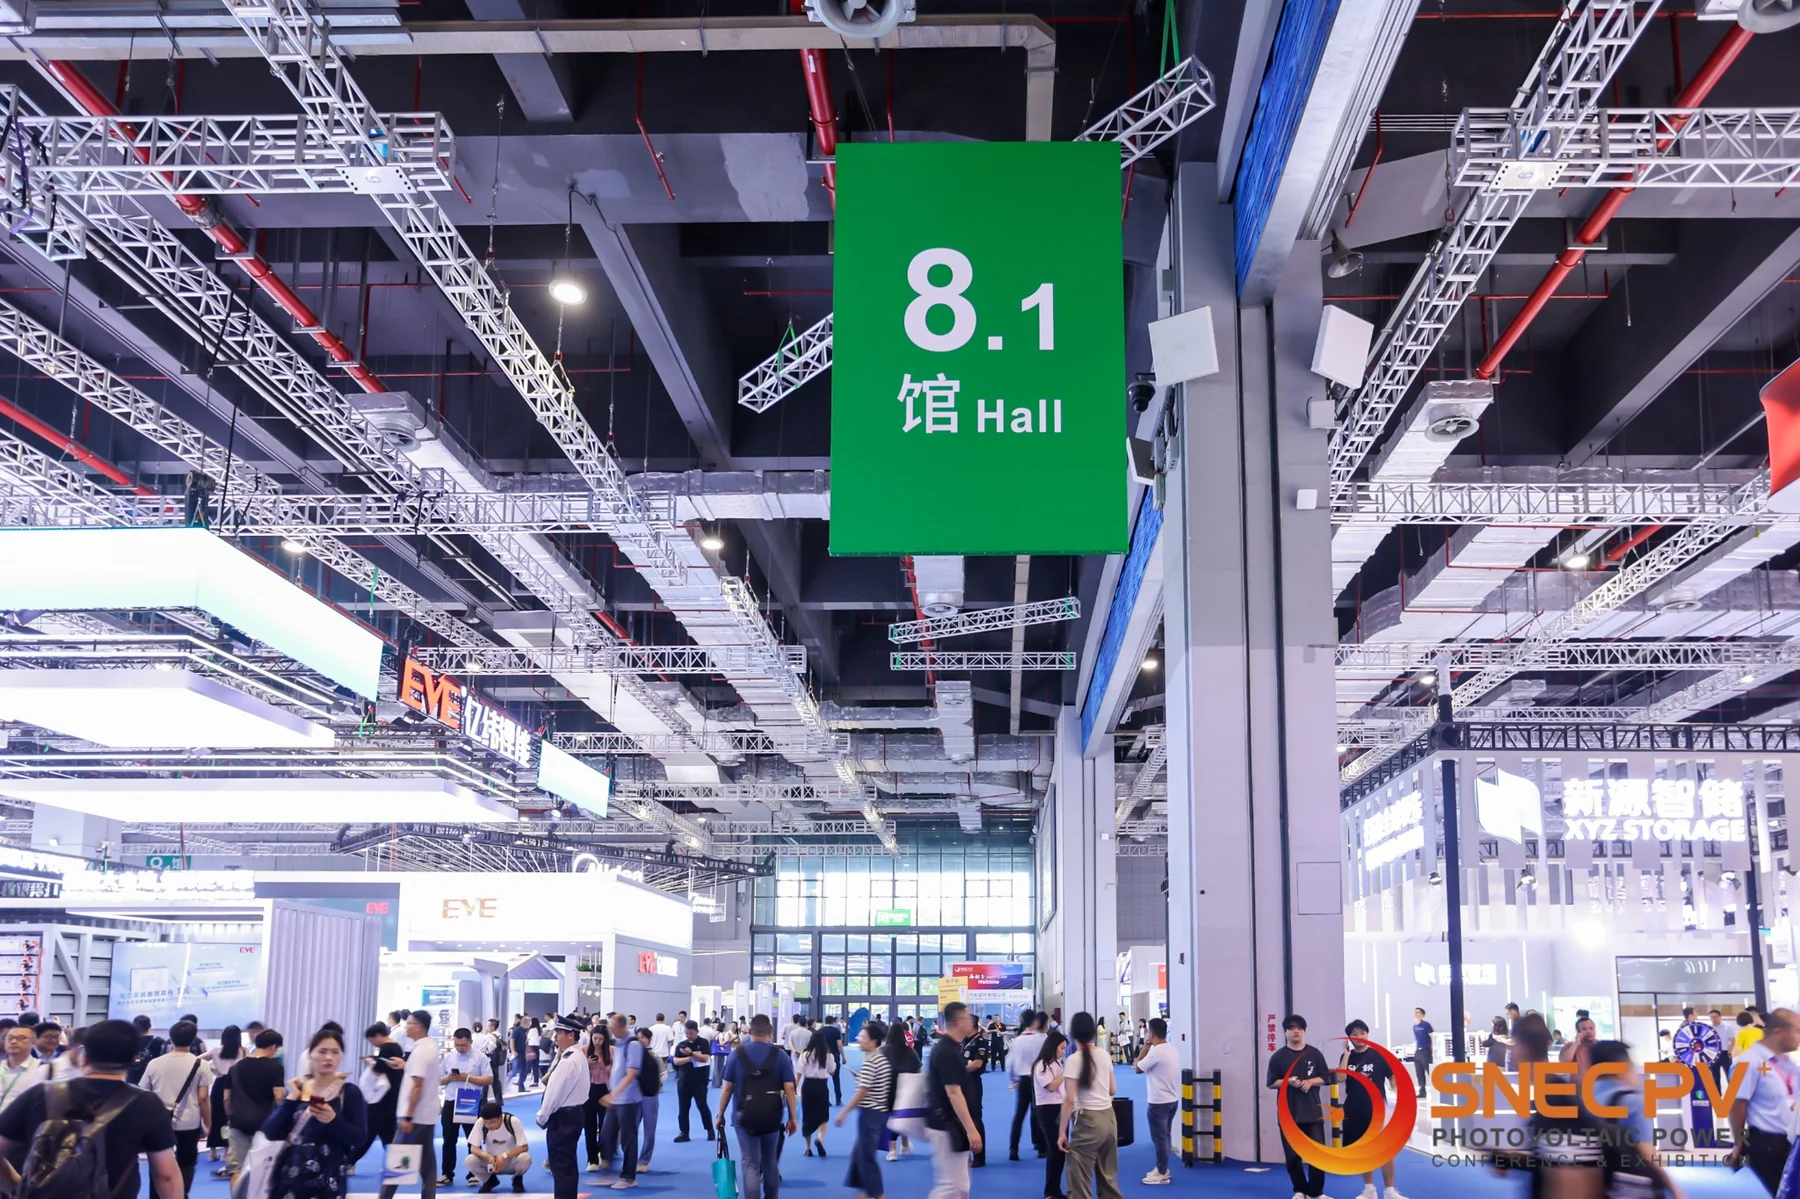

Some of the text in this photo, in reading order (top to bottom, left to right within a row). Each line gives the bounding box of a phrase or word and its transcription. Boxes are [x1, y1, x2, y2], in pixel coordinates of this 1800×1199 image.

[904, 247, 1055, 352] 8.1
[897, 373, 1062, 434] 馆 Hall
[401, 656, 461, 731] EVE
[1562, 777, 1744, 819] 新源智储
[1563, 818, 1747, 841] XYZ STORAGE
[365, 902, 389, 915] EVE
[442, 897, 498, 919] EVE
[239, 946, 256, 954] EVE
[1267, 1014, 1276, 1052] 严禁停车
